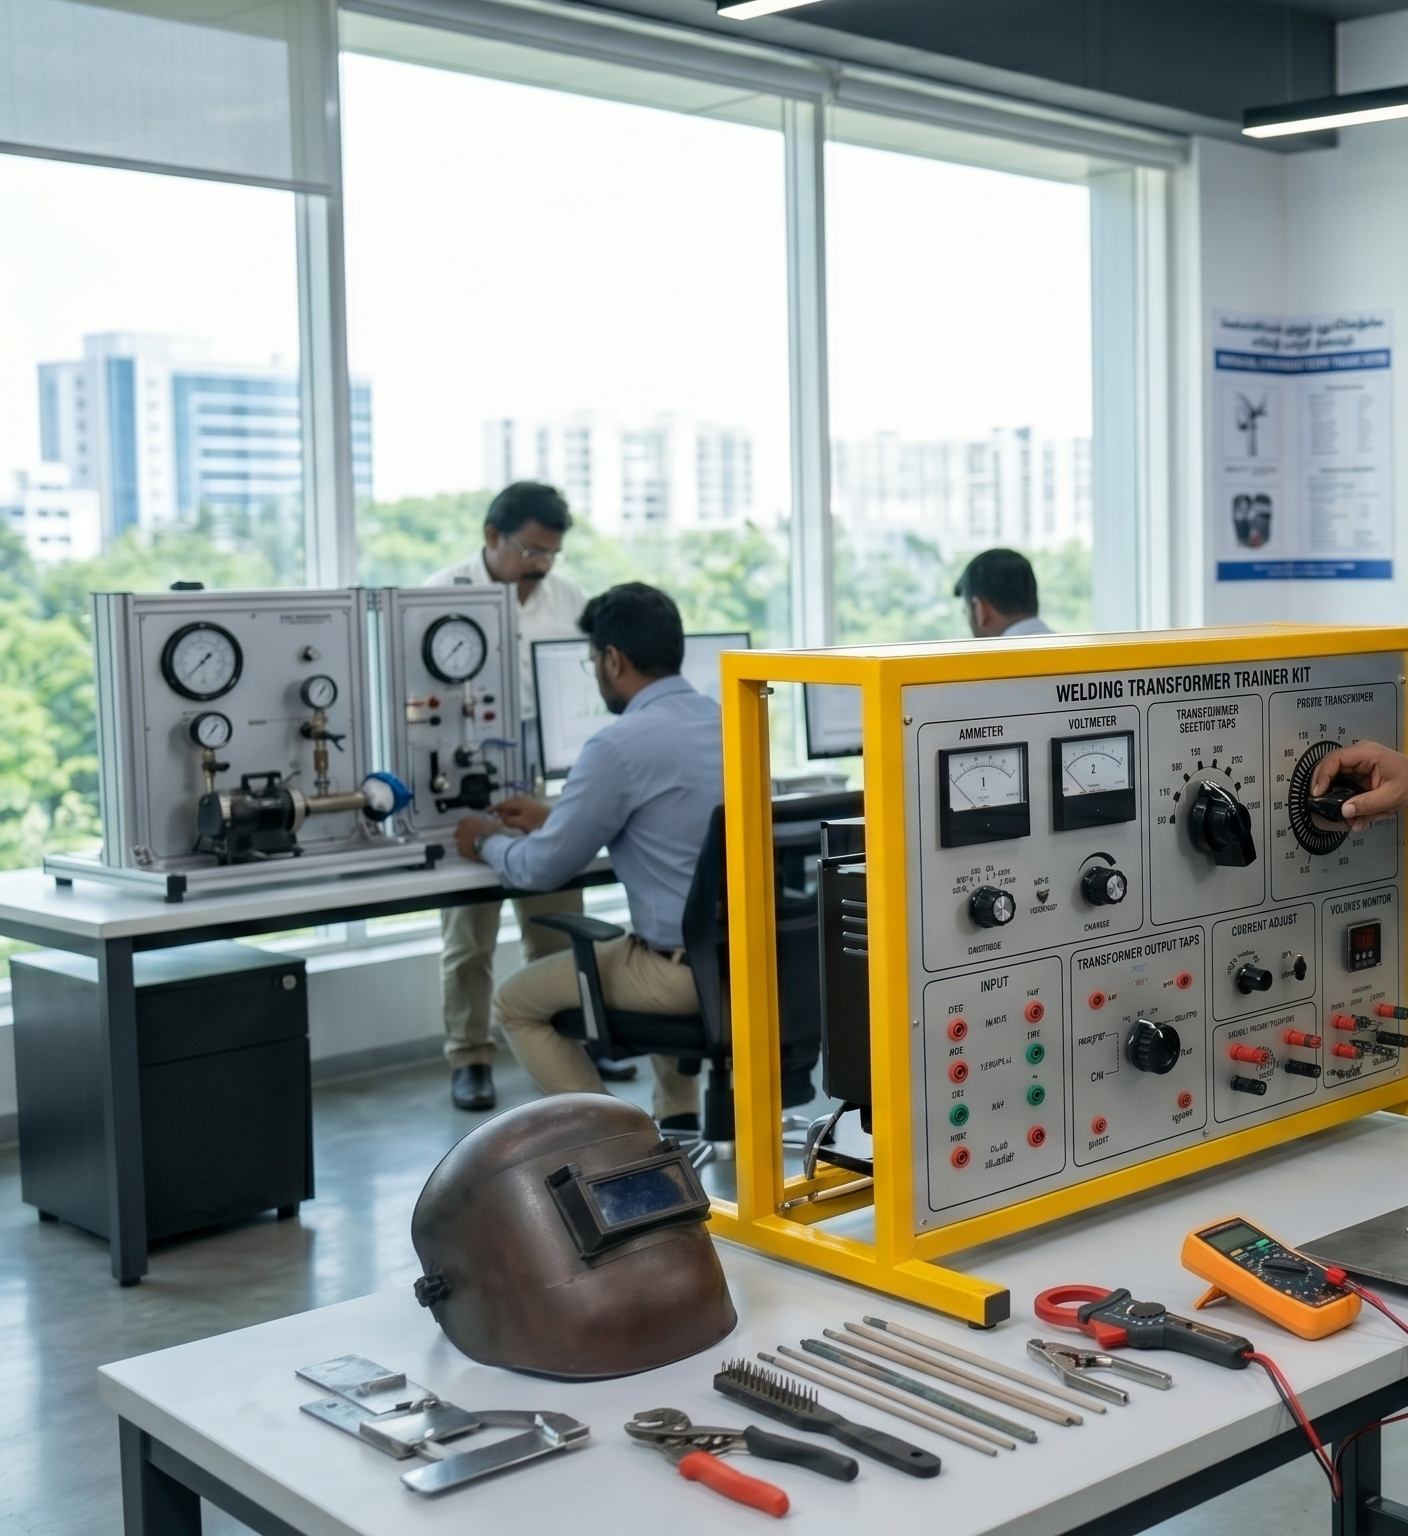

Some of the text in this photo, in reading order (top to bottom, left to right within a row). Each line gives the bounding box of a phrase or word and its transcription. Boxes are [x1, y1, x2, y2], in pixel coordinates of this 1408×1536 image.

[1056, 666, 1311, 702] WELDING TRANSFORMER TRAINER KIT
[1068, 715, 1117, 730] VOLTMETER
[1217, 717, 1236, 730] TAPS
[958, 725, 1004, 740] AMMETER
[1091, 764, 1096, 774] 2
[1268, 913, 1298, 929] ADJUST
[1077, 946, 1142, 971] TRANSFORMER
[1144, 939, 1177, 956] OUTPUT
[1179, 934, 1200, 948] TAPS
[980, 975, 1009, 993] INPUT
